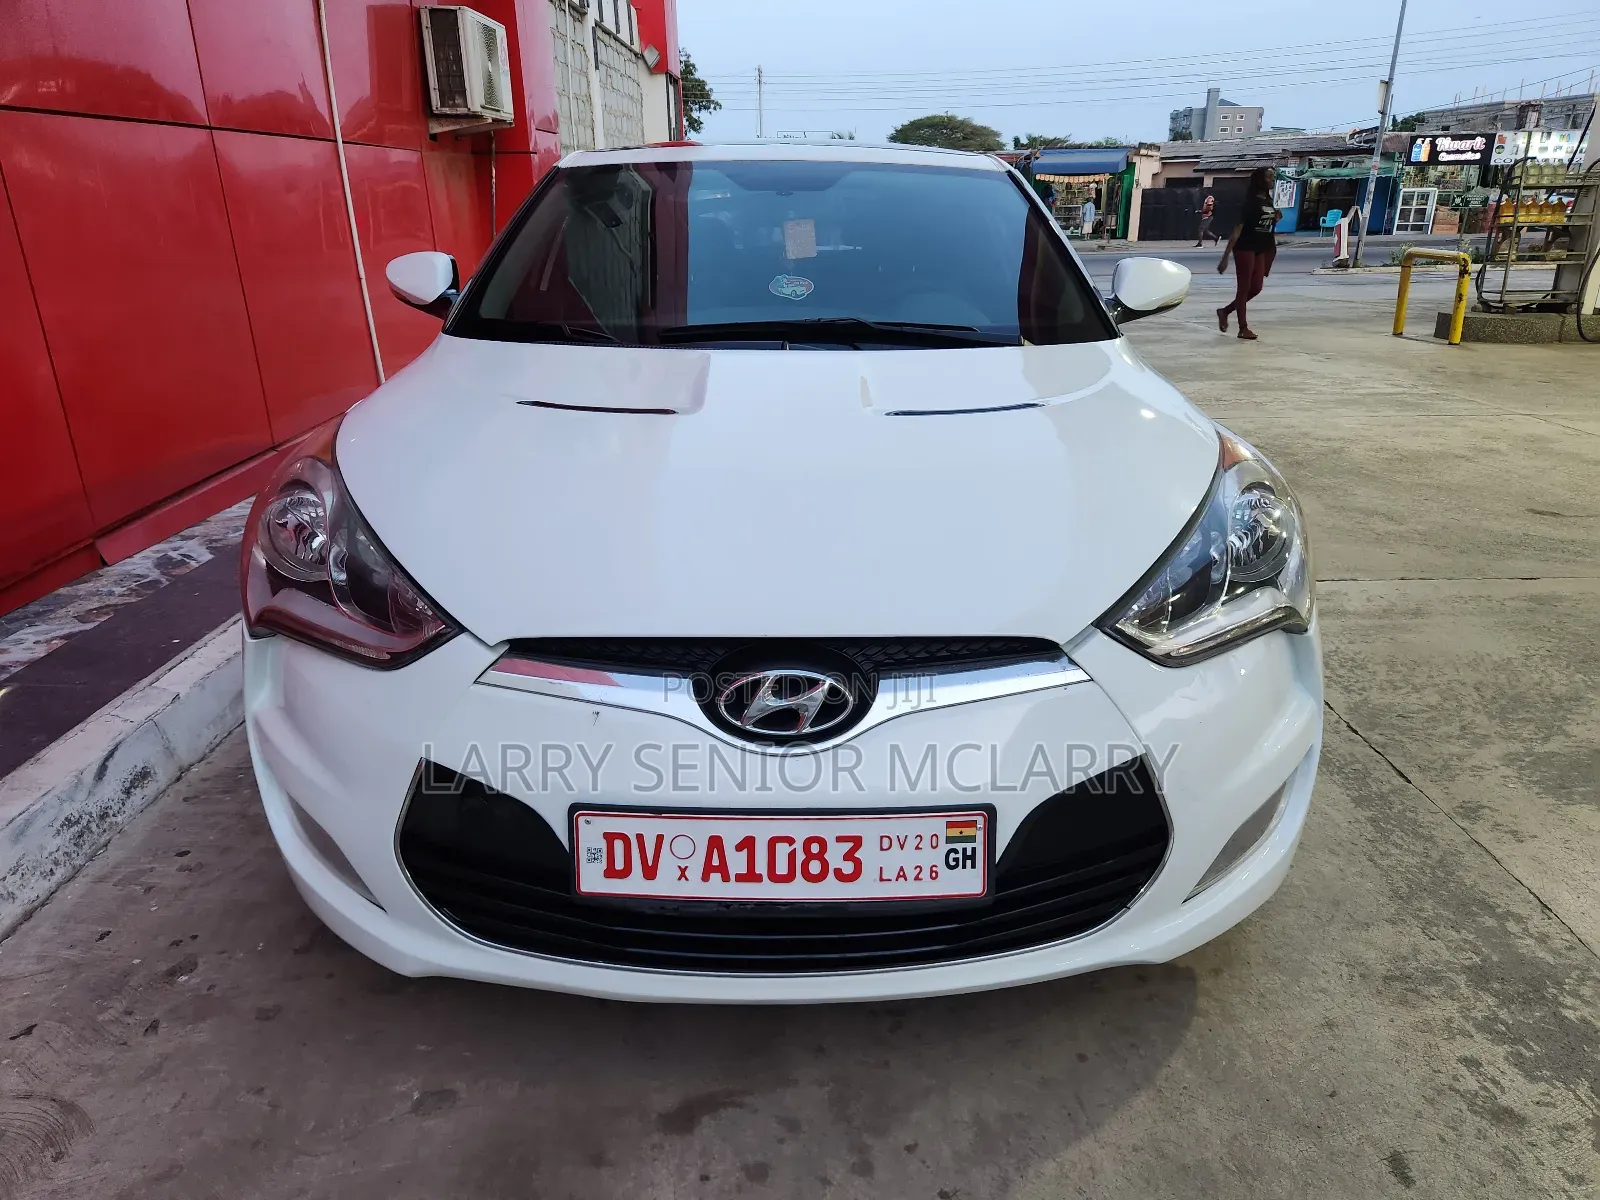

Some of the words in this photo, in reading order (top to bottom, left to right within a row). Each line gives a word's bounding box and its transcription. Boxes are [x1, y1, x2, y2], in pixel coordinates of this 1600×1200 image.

[602, 831, 664, 881] DV
[701, 834, 863, 883] A1083
[944, 847, 977, 870] GH
